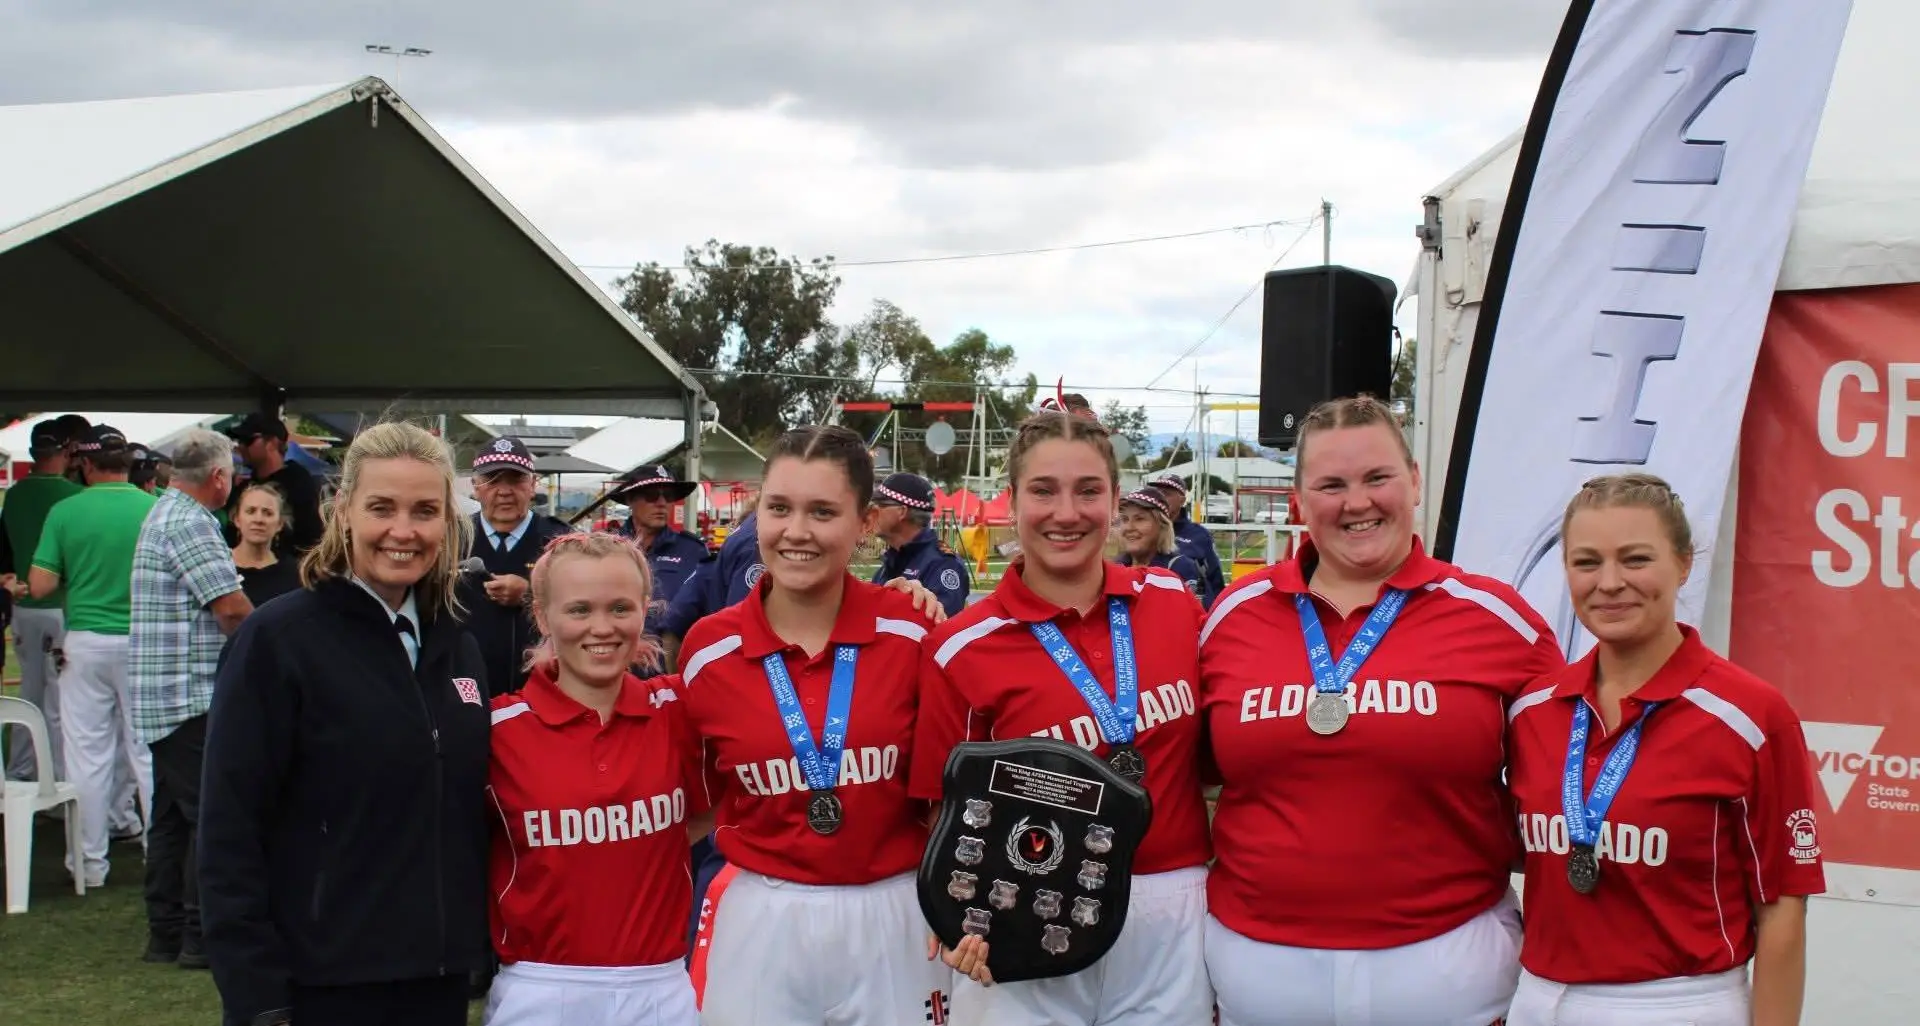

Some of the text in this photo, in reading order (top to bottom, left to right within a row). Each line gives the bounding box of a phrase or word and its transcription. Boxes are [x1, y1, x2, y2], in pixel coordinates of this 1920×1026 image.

[1811, 488, 1920, 588] St
[1372, 605, 1388, 623] STATE
[774, 662, 796, 706] FIREFIGHTER
[1115, 631, 1127, 696] STATE FIREFIGHTER
[1123, 637, 1134, 690] CHAMPIONSHIPS
[784, 715, 793, 730] CFA
[1081, 686, 1119, 743] CHAMPIONSHIPS
[1084, 678, 1128, 744] STATE FIREFIGHTER
[806, 751, 821, 776] STATE
[1593, 774, 1611, 799] STATE
[1603, 737, 1637, 796] CHAMPIONSHIPS
[1868, 783, 1910, 798] State
[524, 787, 686, 847] ELDORADO
[1564, 771, 1577, 836] CHAMPIONSHIPS
[1572, 786, 1585, 841] FIREFIGHTER
